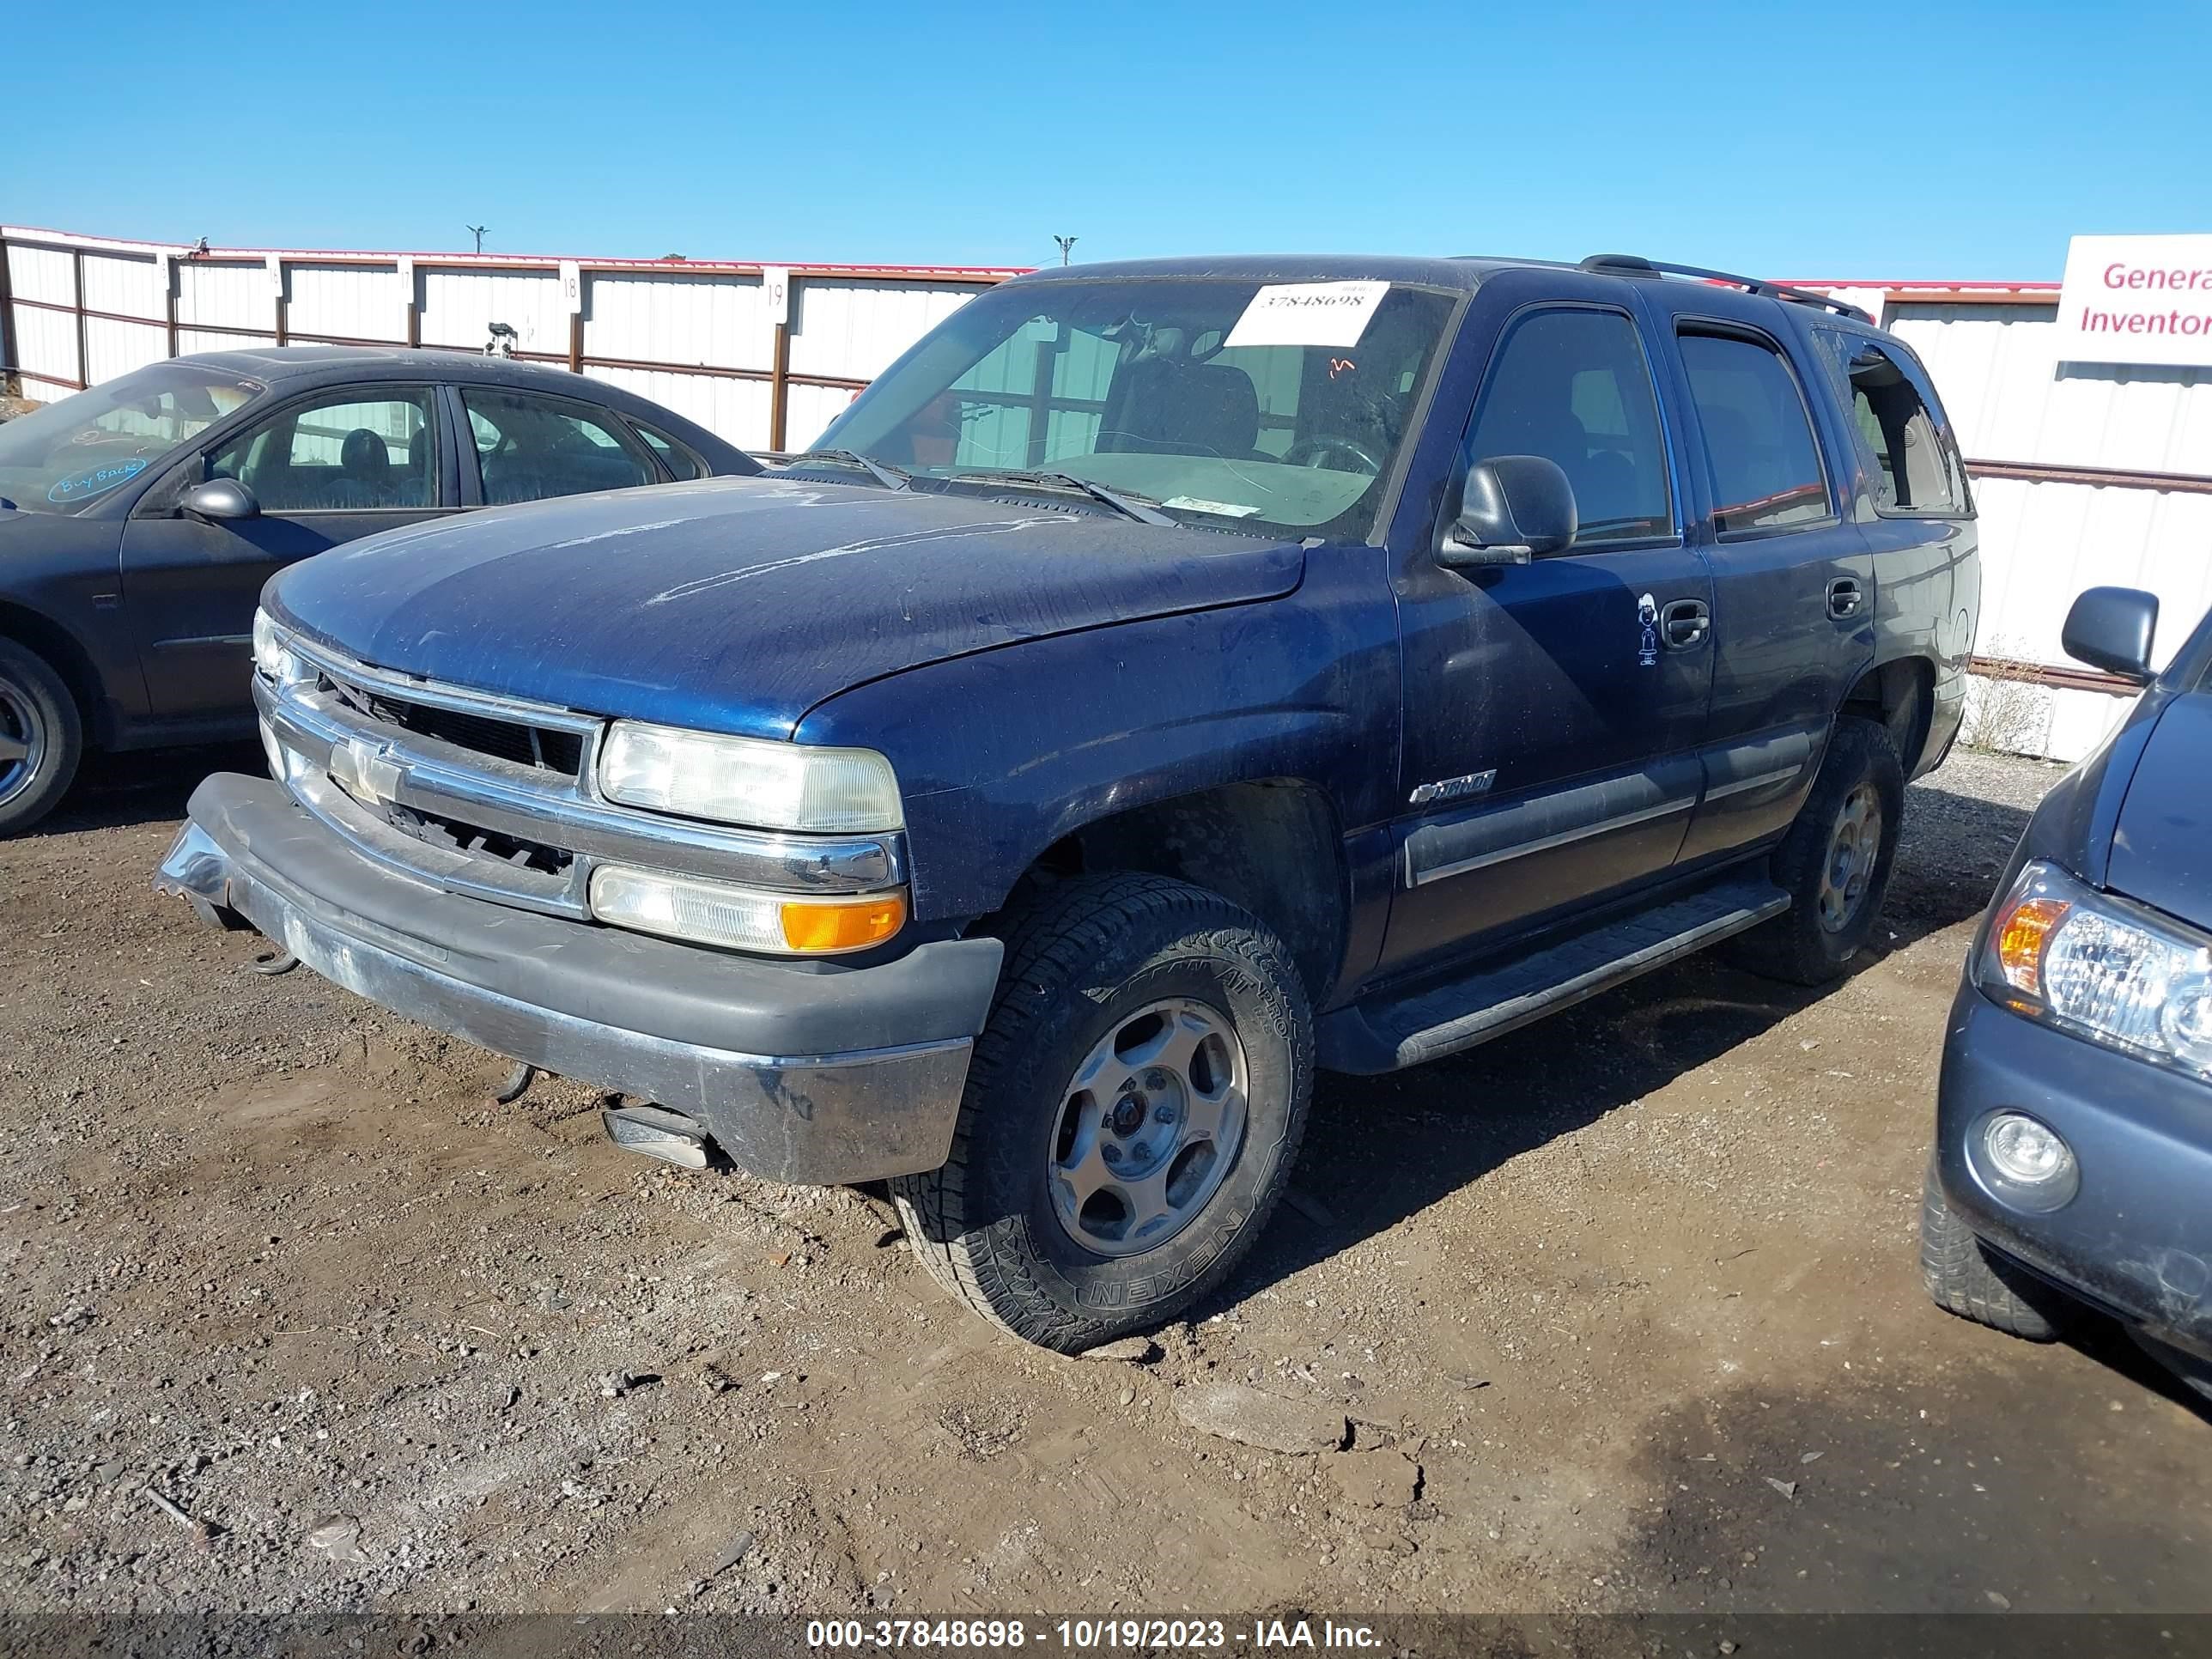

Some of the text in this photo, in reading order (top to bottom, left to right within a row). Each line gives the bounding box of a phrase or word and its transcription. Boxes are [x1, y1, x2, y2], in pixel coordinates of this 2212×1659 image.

[270, 266, 278, 285] 16
[401, 270, 410, 289] 17
[564, 277, 577, 298] 18
[769, 284, 783, 307] 19
[1261, 295, 1365, 308] 37848698
[96, 464, 137, 482] BACK
[1214, 967, 1256, 994] AT
[1255, 985, 1289, 1039] PRO
[1088, 1208, 1245, 1306] NEXEN
